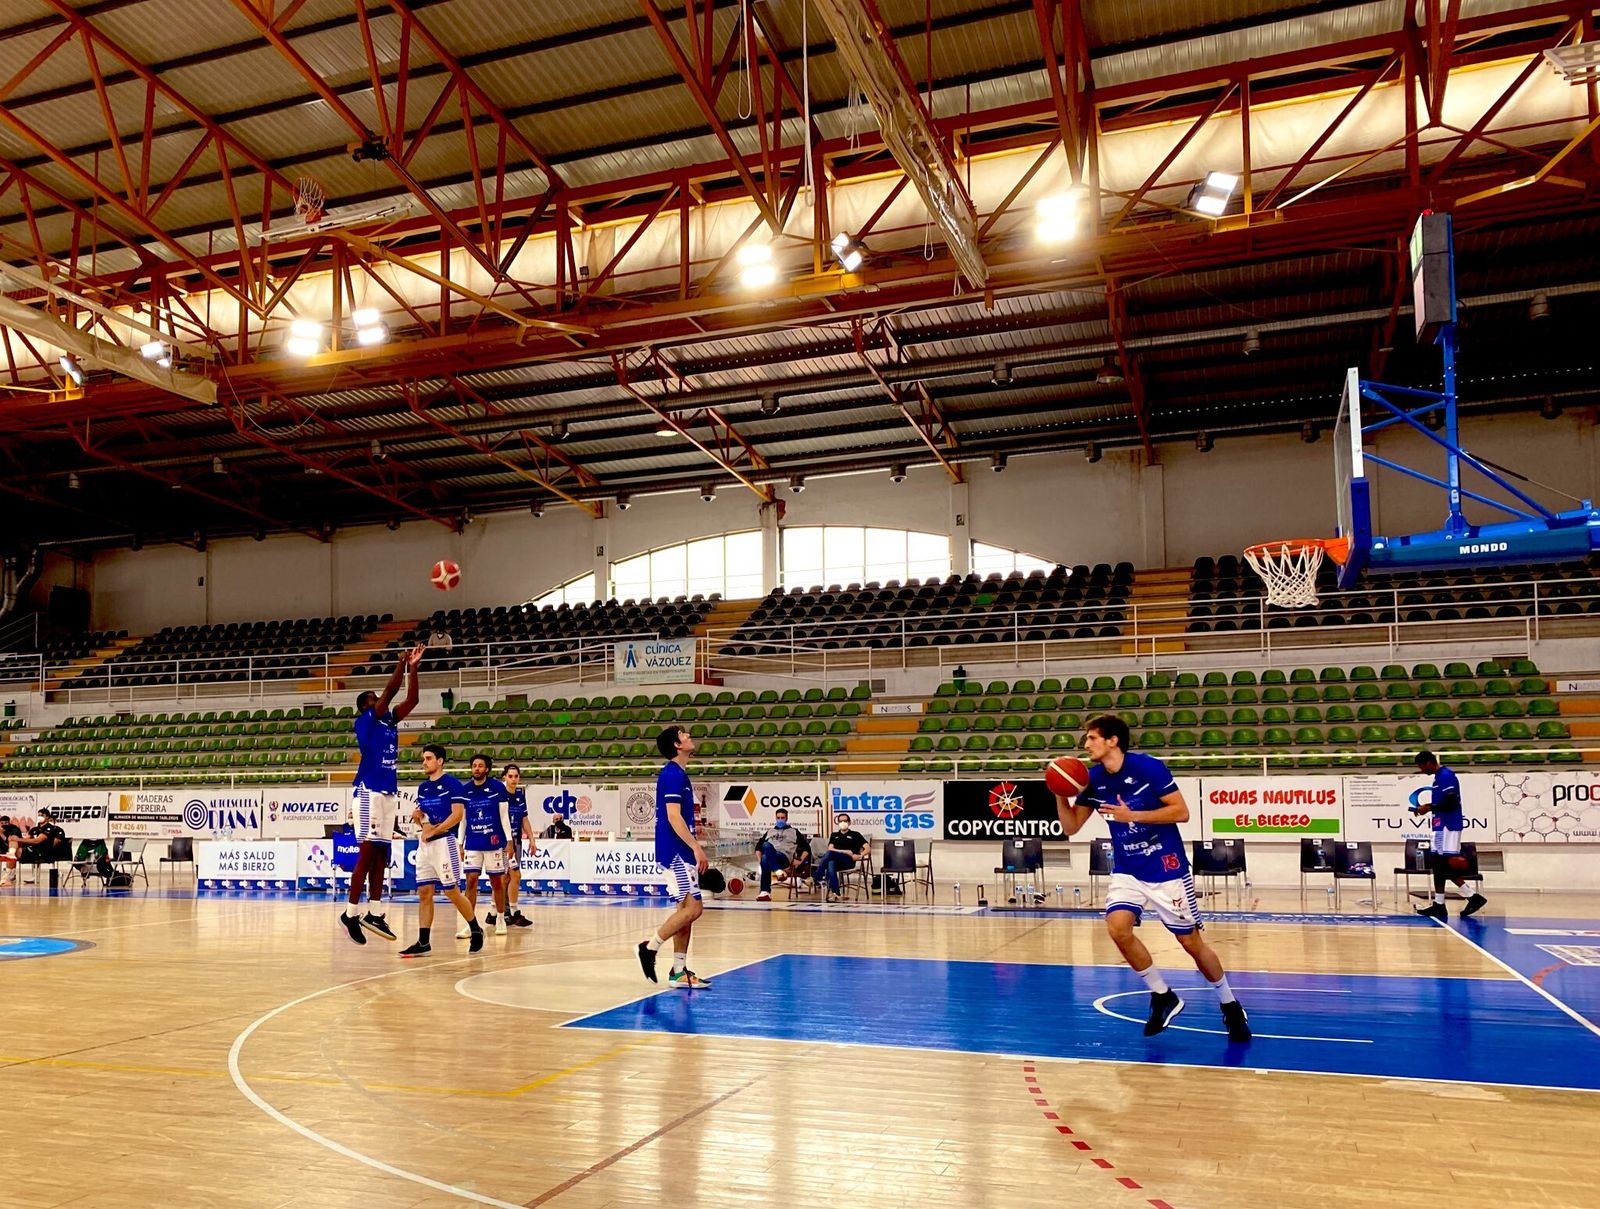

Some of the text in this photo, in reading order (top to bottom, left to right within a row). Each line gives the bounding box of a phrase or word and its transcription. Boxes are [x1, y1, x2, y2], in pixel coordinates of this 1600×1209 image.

[1459, 542, 1508, 555] MONDO
[645, 655, 692, 668] VÁZQUEZ
[136, 794, 174, 803] MADERAS
[760, 795, 823, 808] COBOSA
[831, 787, 903, 810] intra
[1209, 789, 1258, 805] GRUAS
[1262, 788, 1337, 806] NAUTILUS
[51, 806, 102, 819] BIERZO
[136, 804, 167, 813] PEREIRA
[281, 802, 339, 813] NOVATEC
[208, 809, 259, 830] DIANA
[884, 813, 935, 834] gas
[1235, 813, 1311, 827] EL BIERZO
[1371, 818, 1403, 828] TU
[123, 823, 135, 831] 426
[947, 819, 1064, 836] COPYCENTRO
[1123, 840, 1150, 851] intra
[1143, 842, 1163, 856] gas
[219, 849, 276, 861] MÁS SALUD
[595, 850, 655, 863] MÁS SALU
[219, 860, 276, 872] MÁS BIERZO
[595, 863, 664, 875] MÁS BIERZO
